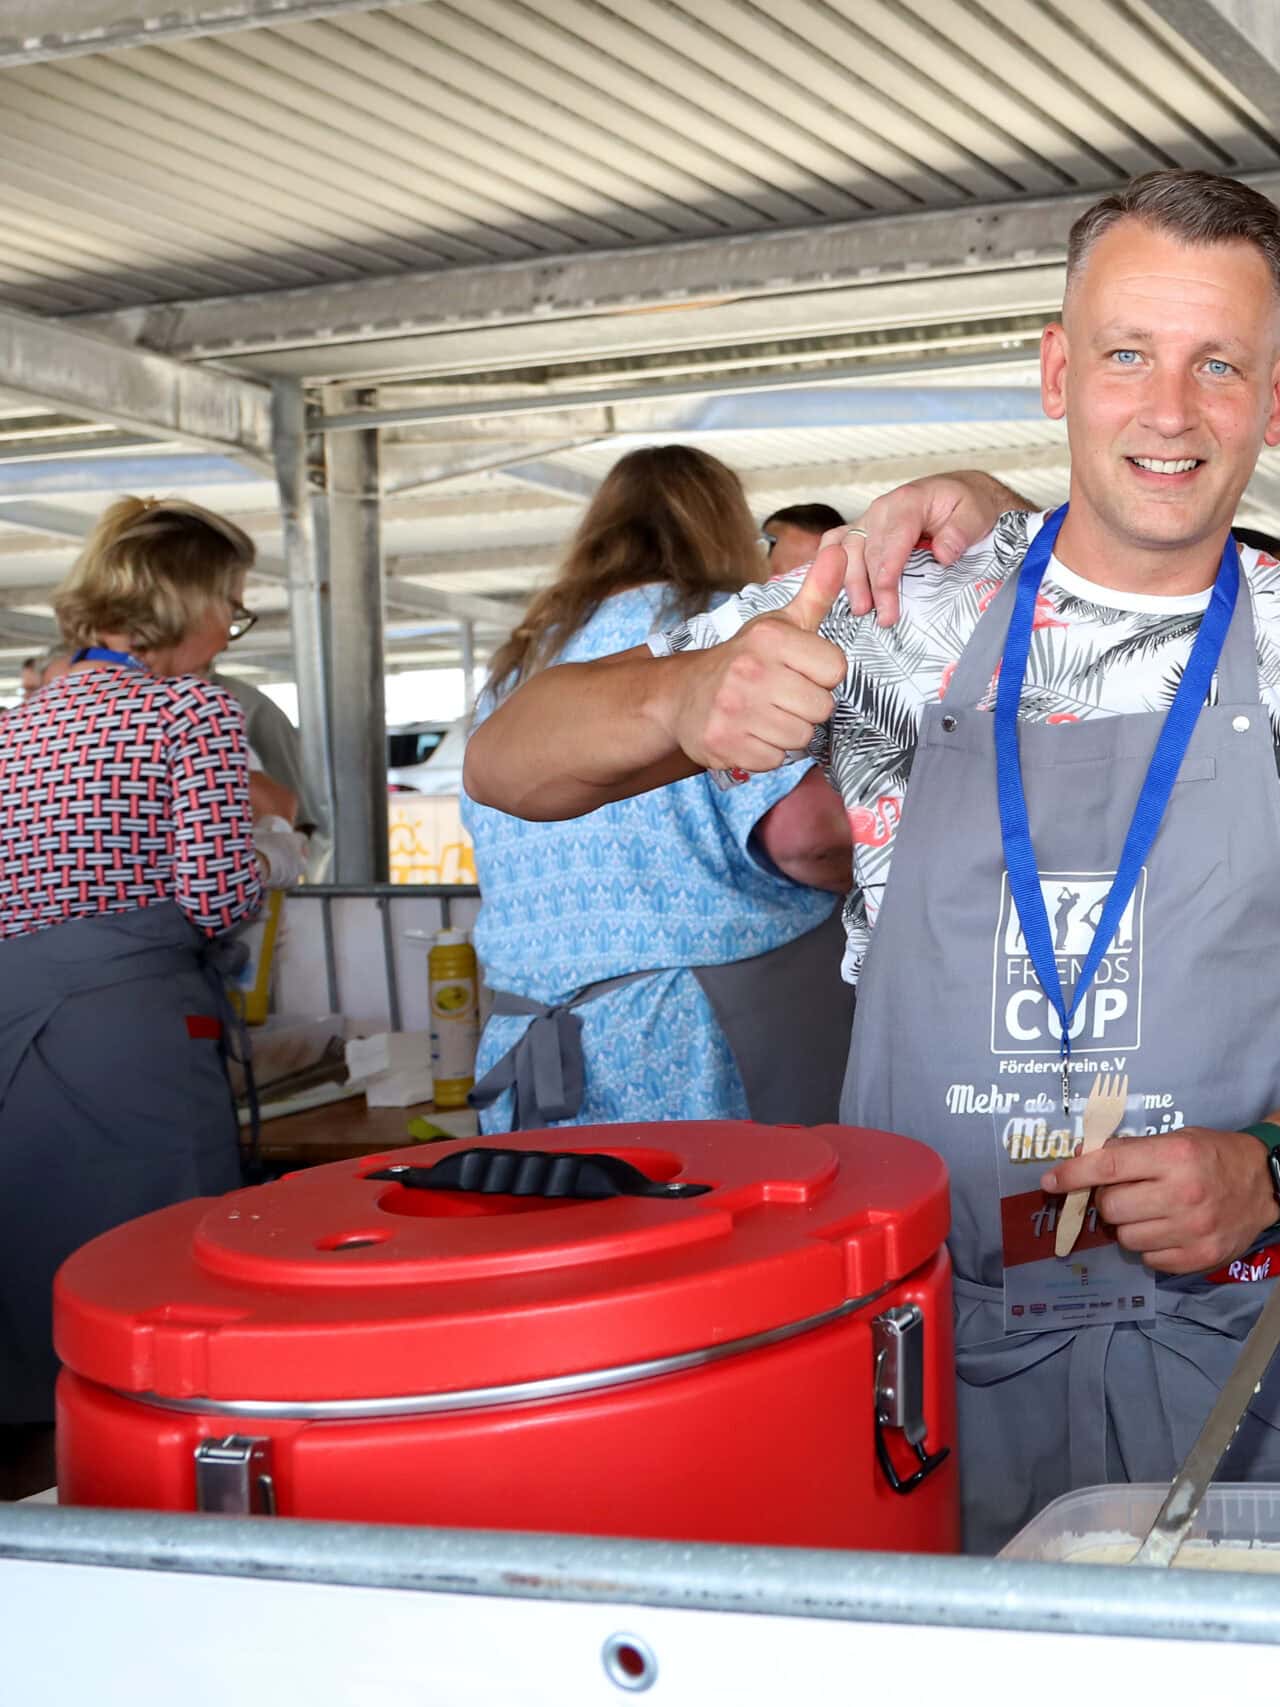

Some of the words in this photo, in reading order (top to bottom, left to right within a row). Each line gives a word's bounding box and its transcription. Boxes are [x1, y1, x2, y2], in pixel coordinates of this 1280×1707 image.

[1006, 957, 1130, 985] FRENDS
[1005, 988, 1128, 1041] CUP
[946, 1084, 1020, 1114] Mehr
[1024, 1092, 1056, 1113] als
